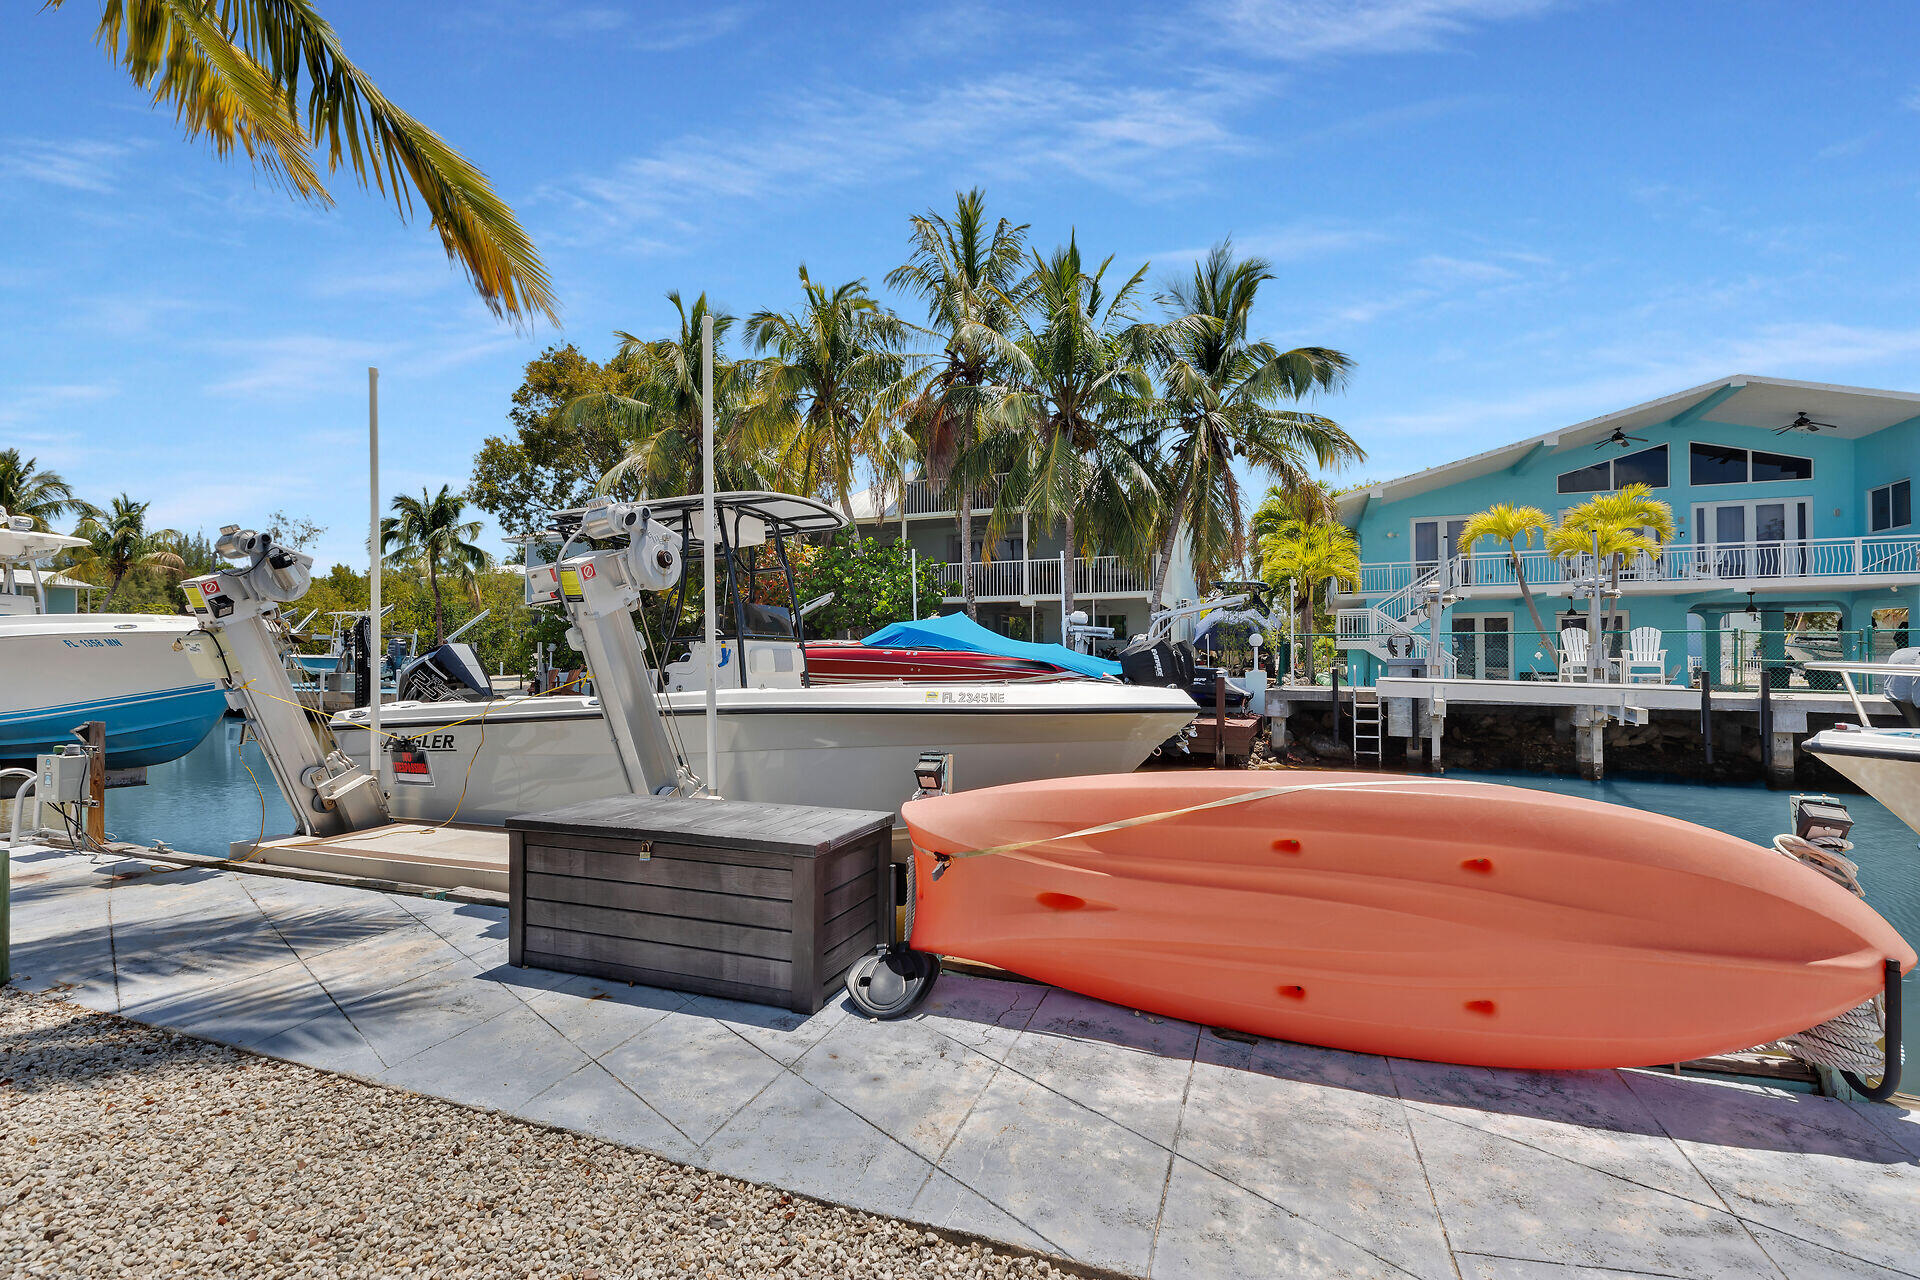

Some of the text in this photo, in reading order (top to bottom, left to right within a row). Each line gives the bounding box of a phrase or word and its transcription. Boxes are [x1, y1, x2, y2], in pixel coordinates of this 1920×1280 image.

[63, 639, 79, 648] FL
[942, 692, 1005, 703] FL 2345 NE
[401, 752, 412, 762] NO
[392, 762, 429, 774] TRESPASSING
